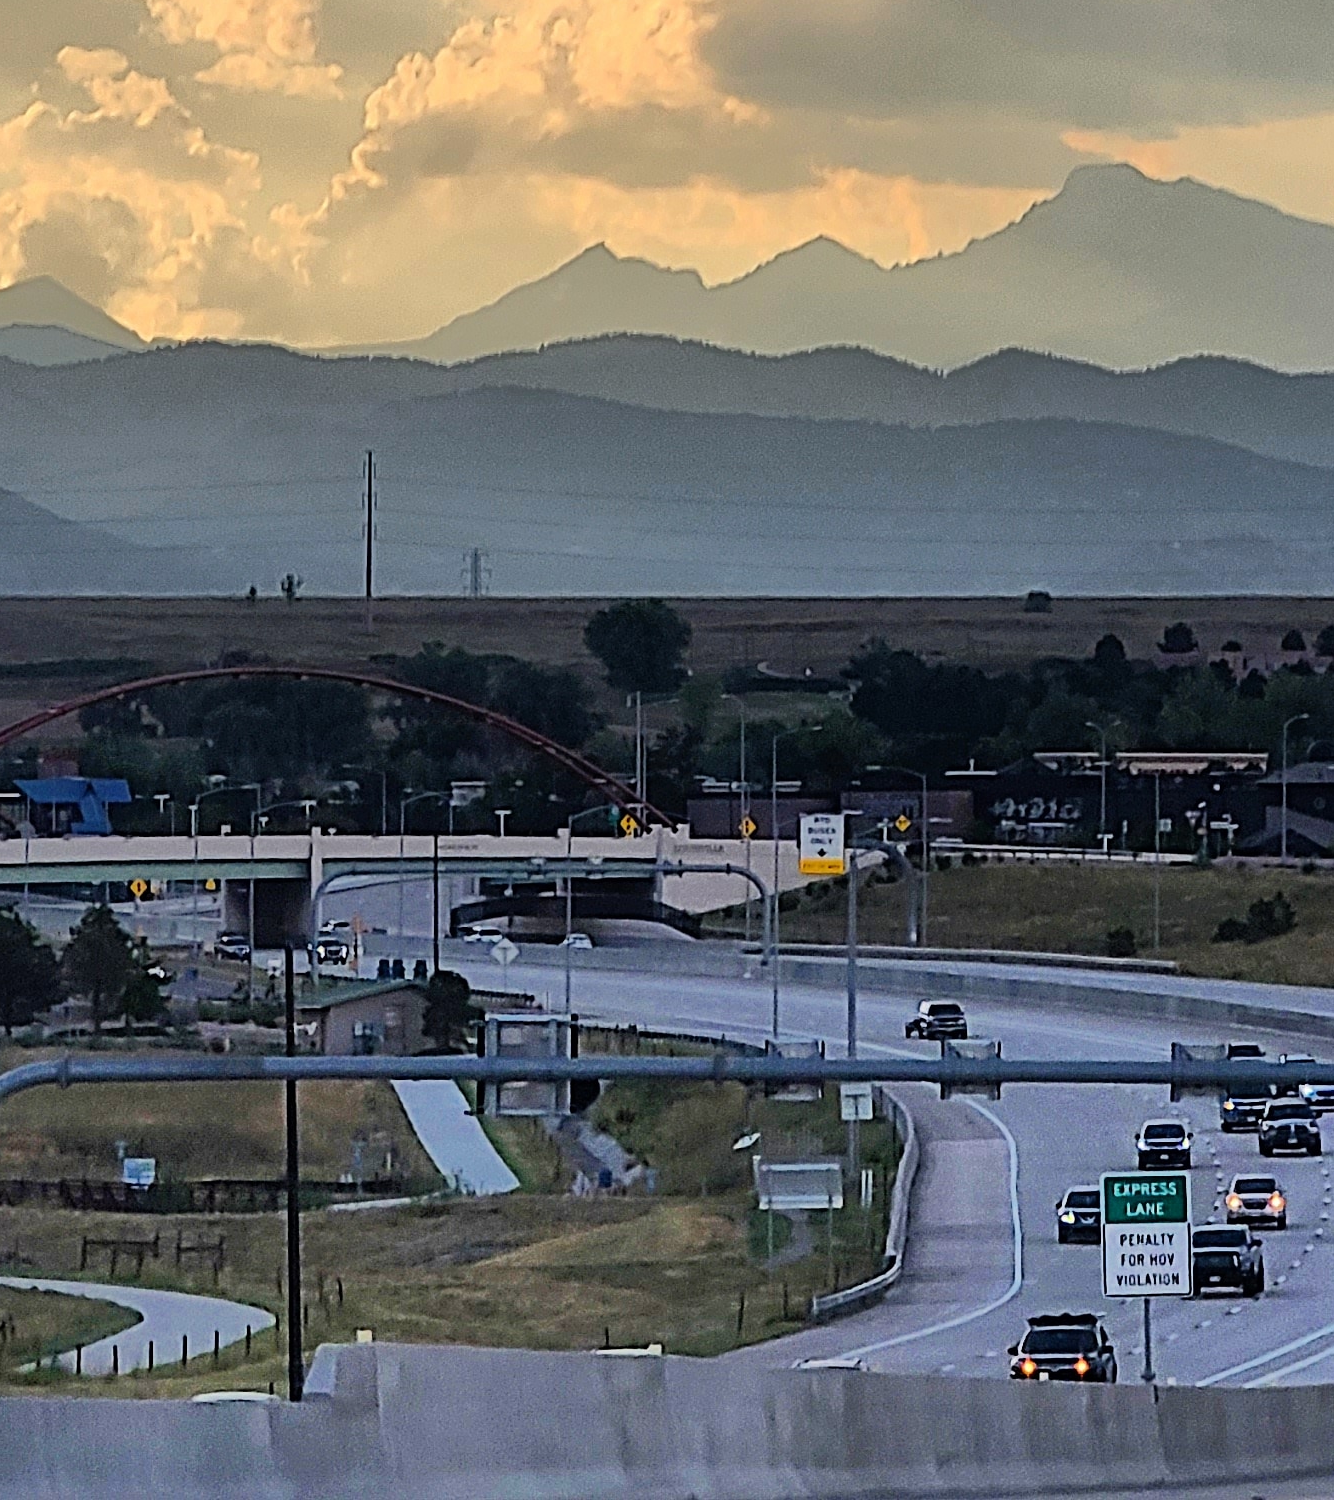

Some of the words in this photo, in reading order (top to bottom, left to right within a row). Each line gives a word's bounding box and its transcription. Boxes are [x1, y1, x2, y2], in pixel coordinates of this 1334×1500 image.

[1113, 1182, 1178, 1198] EXPRESS
[1126, 1202, 1165, 1217] LANE
[1119, 1232, 1175, 1247] PENALTY
[1120, 1253, 1145, 1267] FOR
[1149, 1252, 1175, 1267] HOV
[1116, 1272, 1180, 1287] VIOLATION
